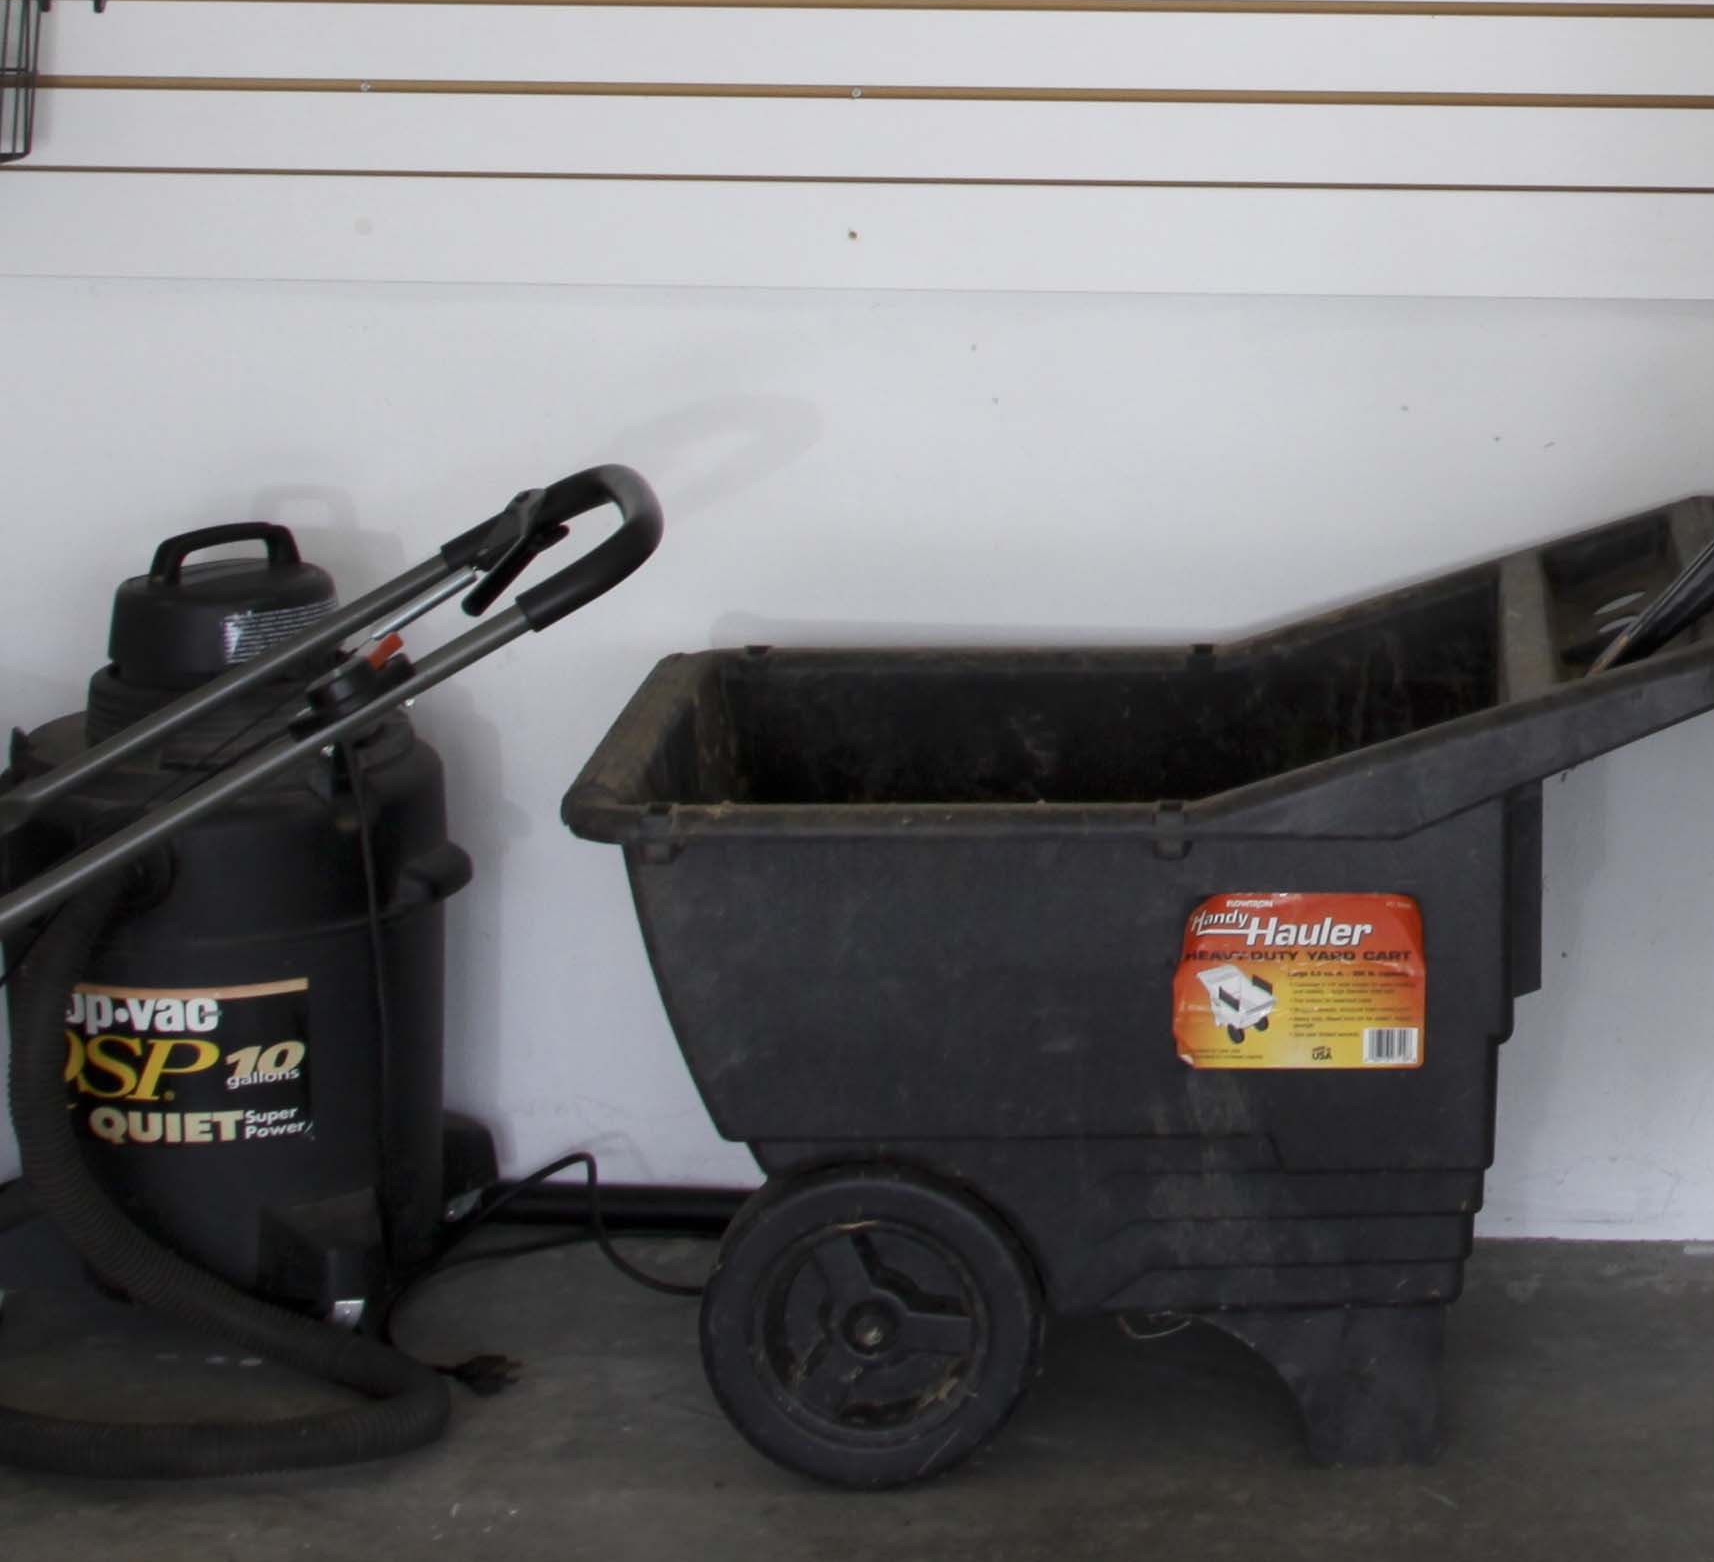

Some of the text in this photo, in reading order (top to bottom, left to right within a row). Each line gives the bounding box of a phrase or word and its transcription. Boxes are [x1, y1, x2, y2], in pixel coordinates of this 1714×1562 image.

[1191, 908, 1249, 936] Handy
[1246, 916, 1373, 946] Hauler
[1308, 950, 1356, 961] YARD
[1362, 950, 1412, 961] CART
[225, 1041, 305, 1078] 10
[226, 1068, 300, 1090] gallons
[89, 1108, 245, 1144] QUIET
[245, 1108, 298, 1125] Super
[245, 1120, 305, 1139] Power
